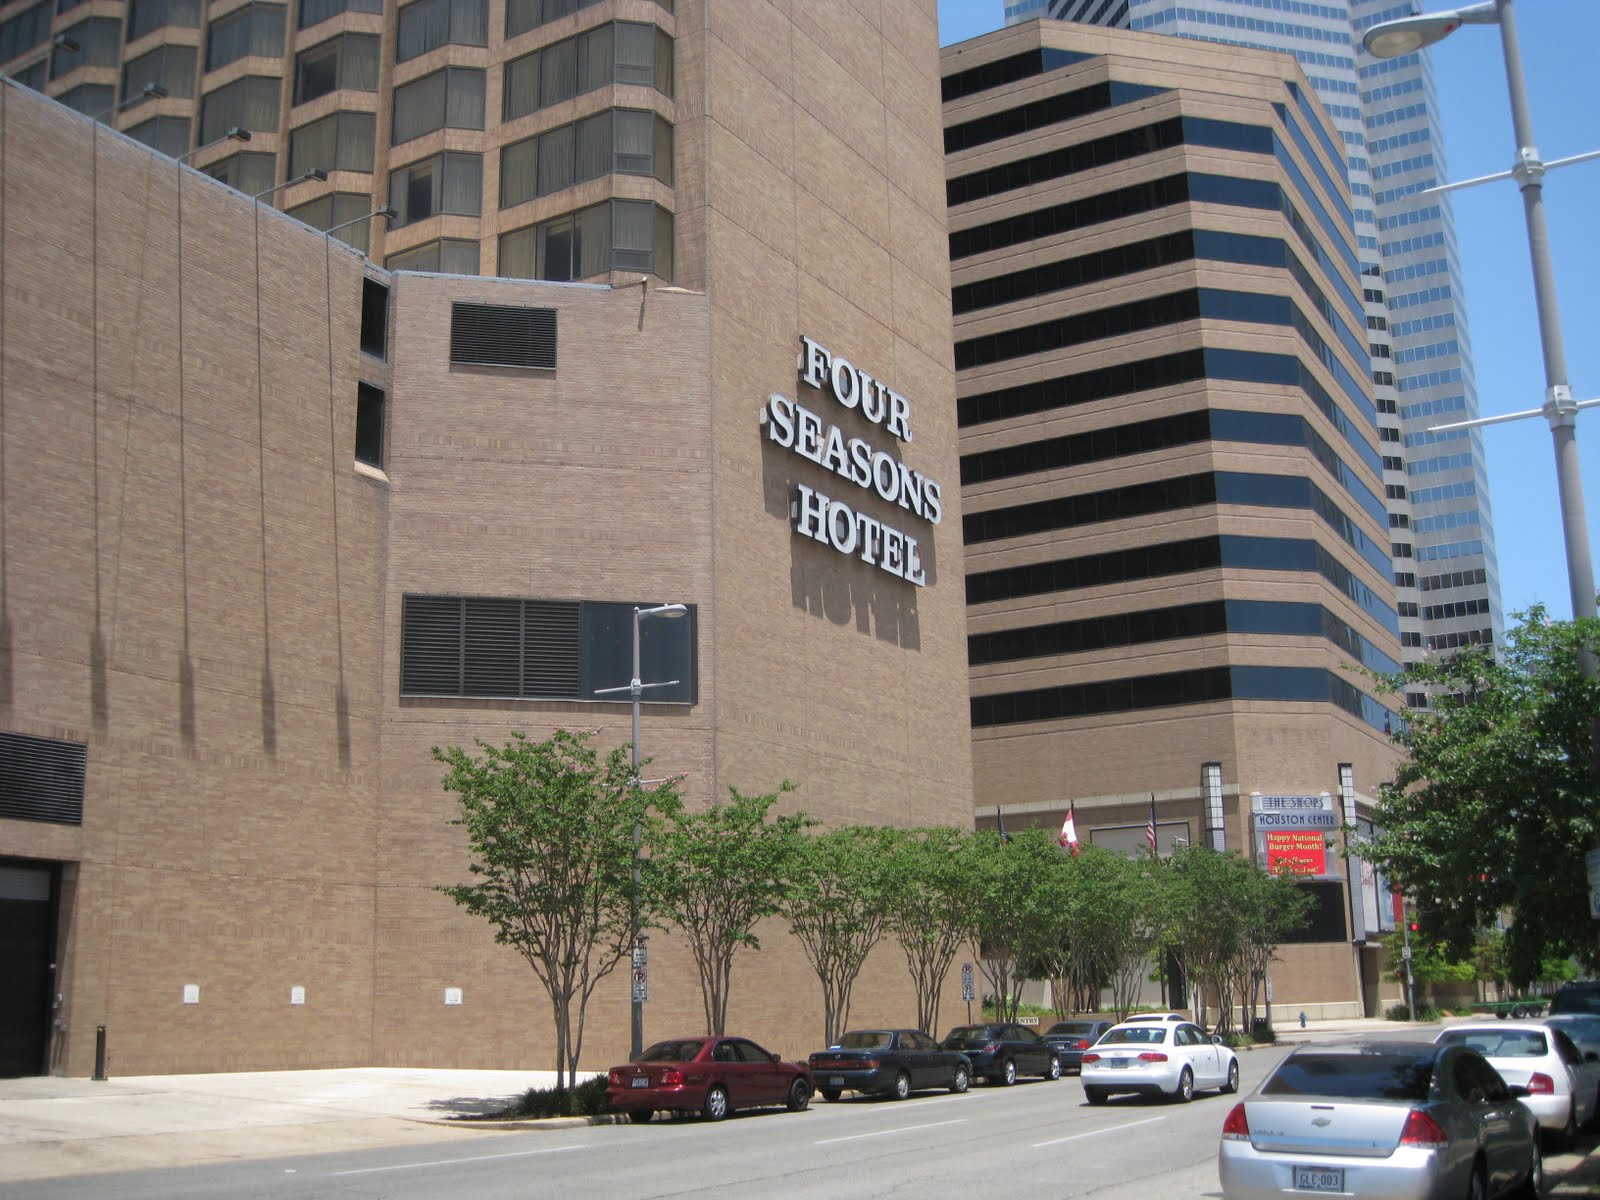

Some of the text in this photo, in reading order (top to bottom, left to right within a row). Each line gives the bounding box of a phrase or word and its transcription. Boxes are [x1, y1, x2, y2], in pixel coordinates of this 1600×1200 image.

[801, 334, 913, 443] FOUR
[767, 393, 942, 526] SEASONS
[797, 483, 926, 588] HOTEL
[1268, 797, 1324, 808] THE SHOPS
[1260, 815, 1335, 825] HOUSTON CENTER
[1267, 833, 1323, 843] Happy National
[1269, 842, 1322, 852] Burger Month!
